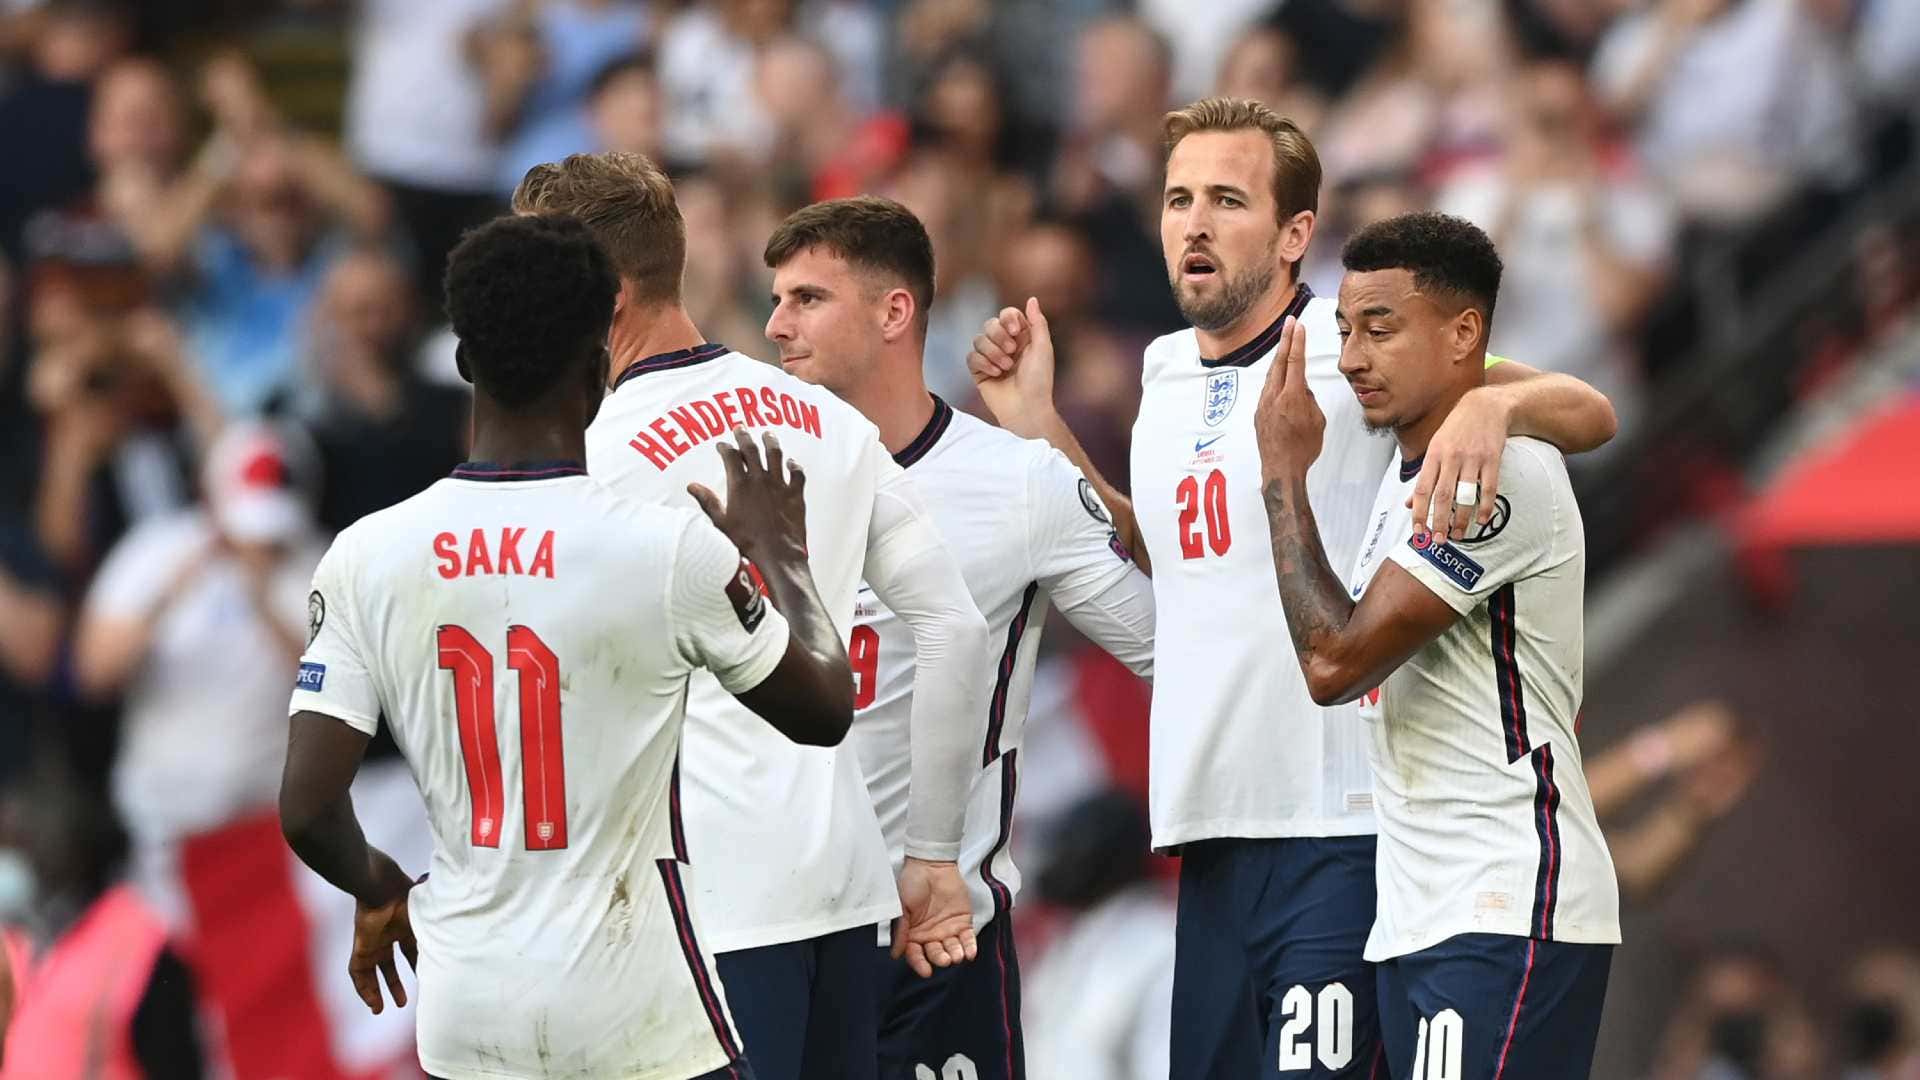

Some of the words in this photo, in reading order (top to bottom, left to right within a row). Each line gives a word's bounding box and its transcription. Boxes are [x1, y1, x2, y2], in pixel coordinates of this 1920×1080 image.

[628, 386, 822, 472] HENDERSON
[433, 527, 555, 579] SAKA
[1176, 468, 1232, 560] 20
[1427, 542, 1480, 583] RESPECT
[437, 624, 568, 850] 11
[1279, 982, 1354, 1071] 20
